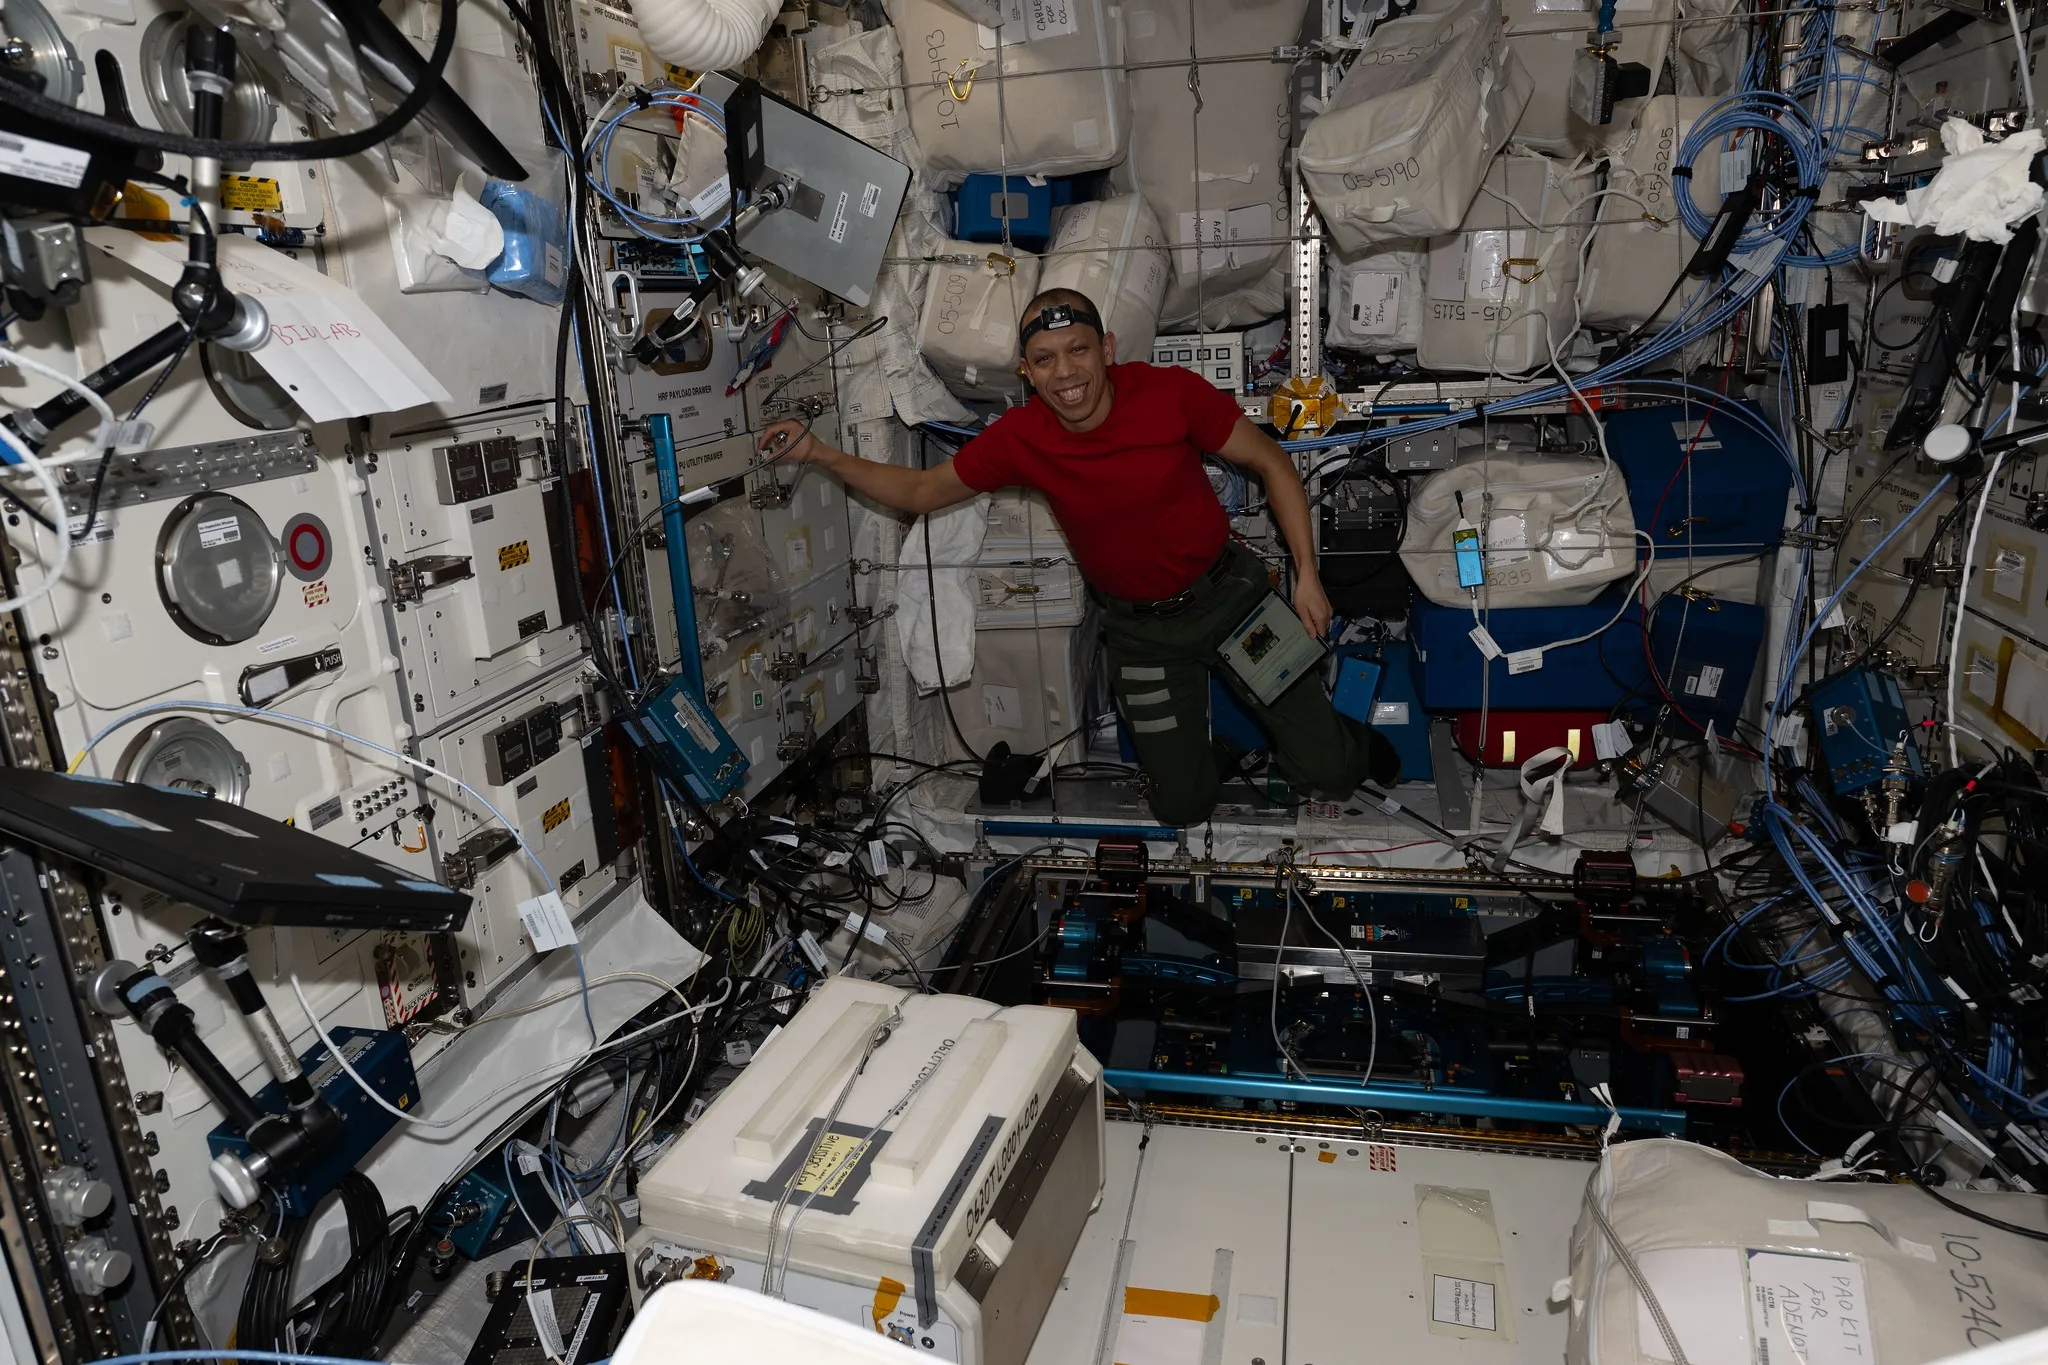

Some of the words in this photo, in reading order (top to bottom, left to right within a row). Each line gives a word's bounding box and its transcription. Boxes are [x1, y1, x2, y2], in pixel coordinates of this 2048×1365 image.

[1046, 5, 1056, 24] FOR
[658, 390, 670, 401] HRF
[670, 387, 692, 400] PAYLOAD
[692, 385, 712, 398] DRAWER
[685, 455, 703, 468] UTILITY
[704, 451, 724, 465] DRAWER
[1900, 487, 1920, 500] DRAWER
[324, 652, 342, 667] PUSH
[1801, 1281, 1828, 1320] FOR
[1831, 1276, 1853, 1312] PAO
[899, 1310, 916, 1319] Power
[564, 1338, 580, 1365] ORTABLE
[575, 1318, 588, 1340] POWER
[584, 1300, 596, 1321] SUPPLY
[1839, 1316, 1862, 1356] KIT
